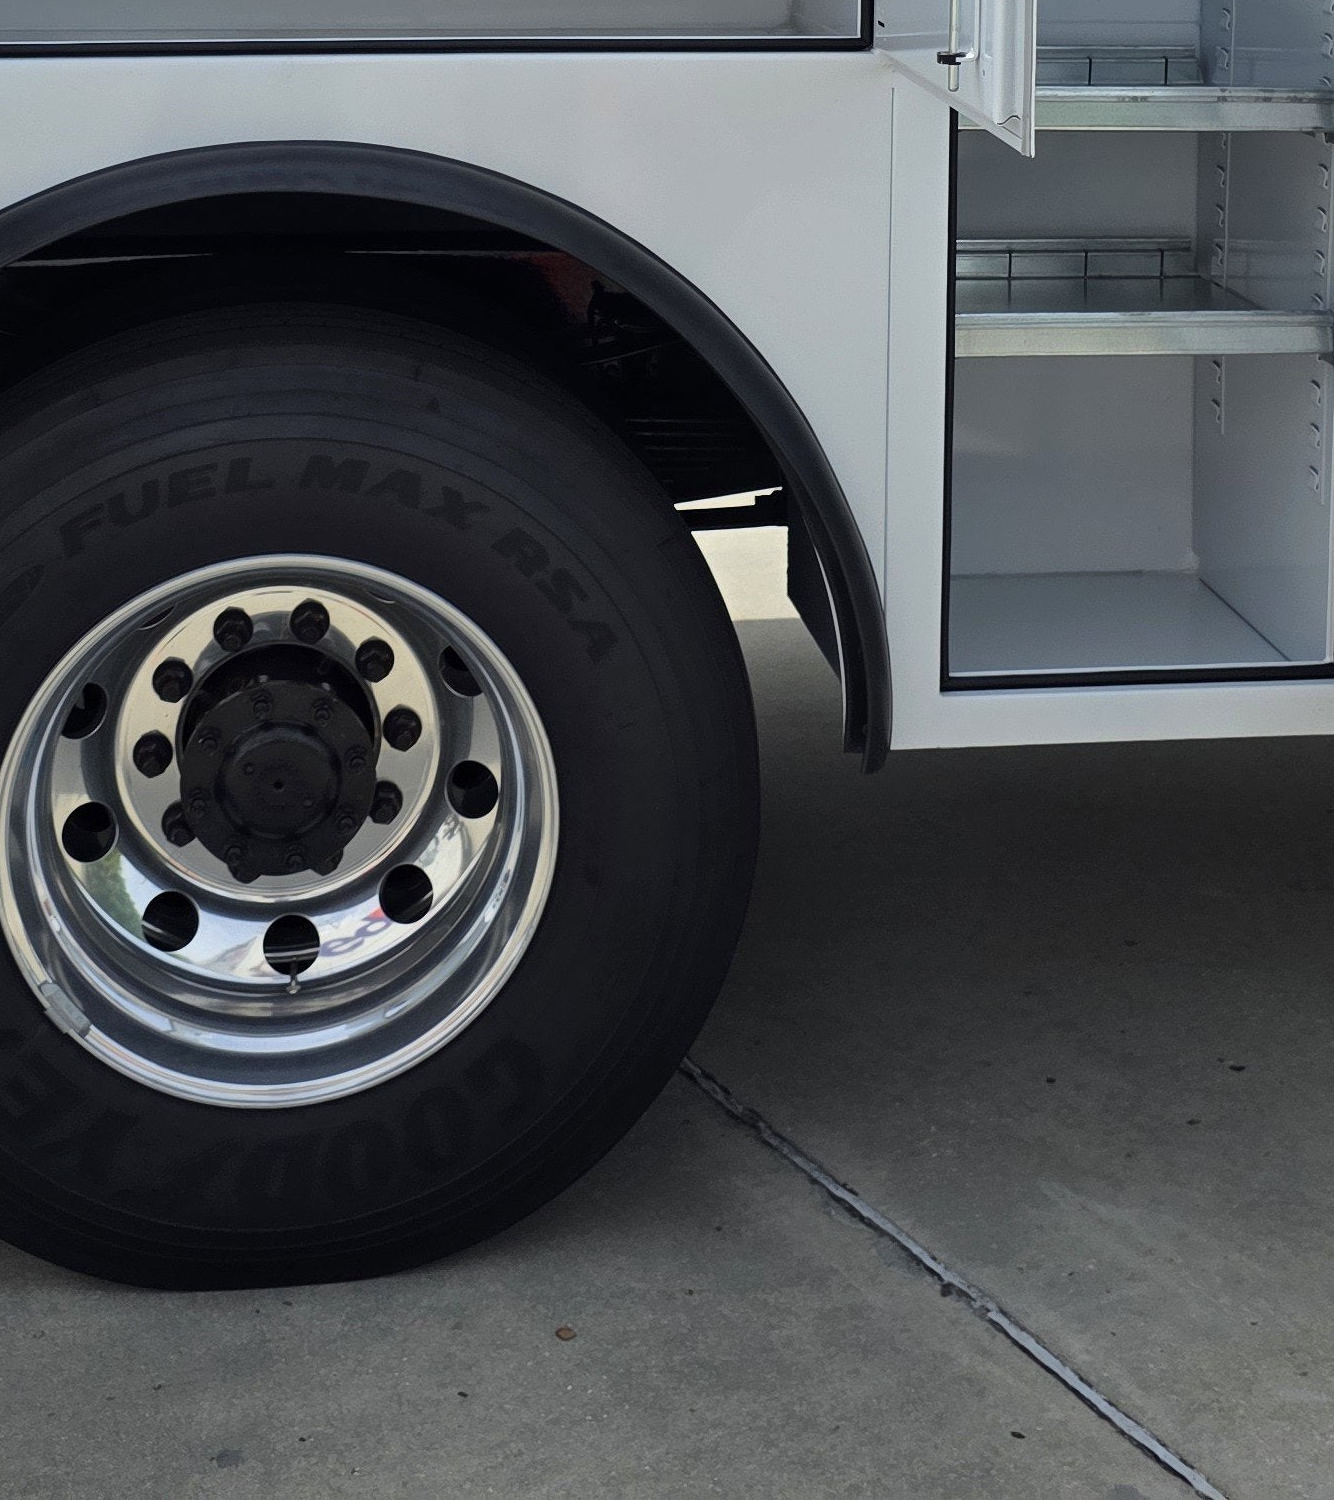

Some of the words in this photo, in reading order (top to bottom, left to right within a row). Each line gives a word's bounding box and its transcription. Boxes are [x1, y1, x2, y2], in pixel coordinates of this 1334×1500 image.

[57, 455, 275, 559] FUEL
[297, 453, 493, 531] MAX
[490, 525, 620, 667] RSA
